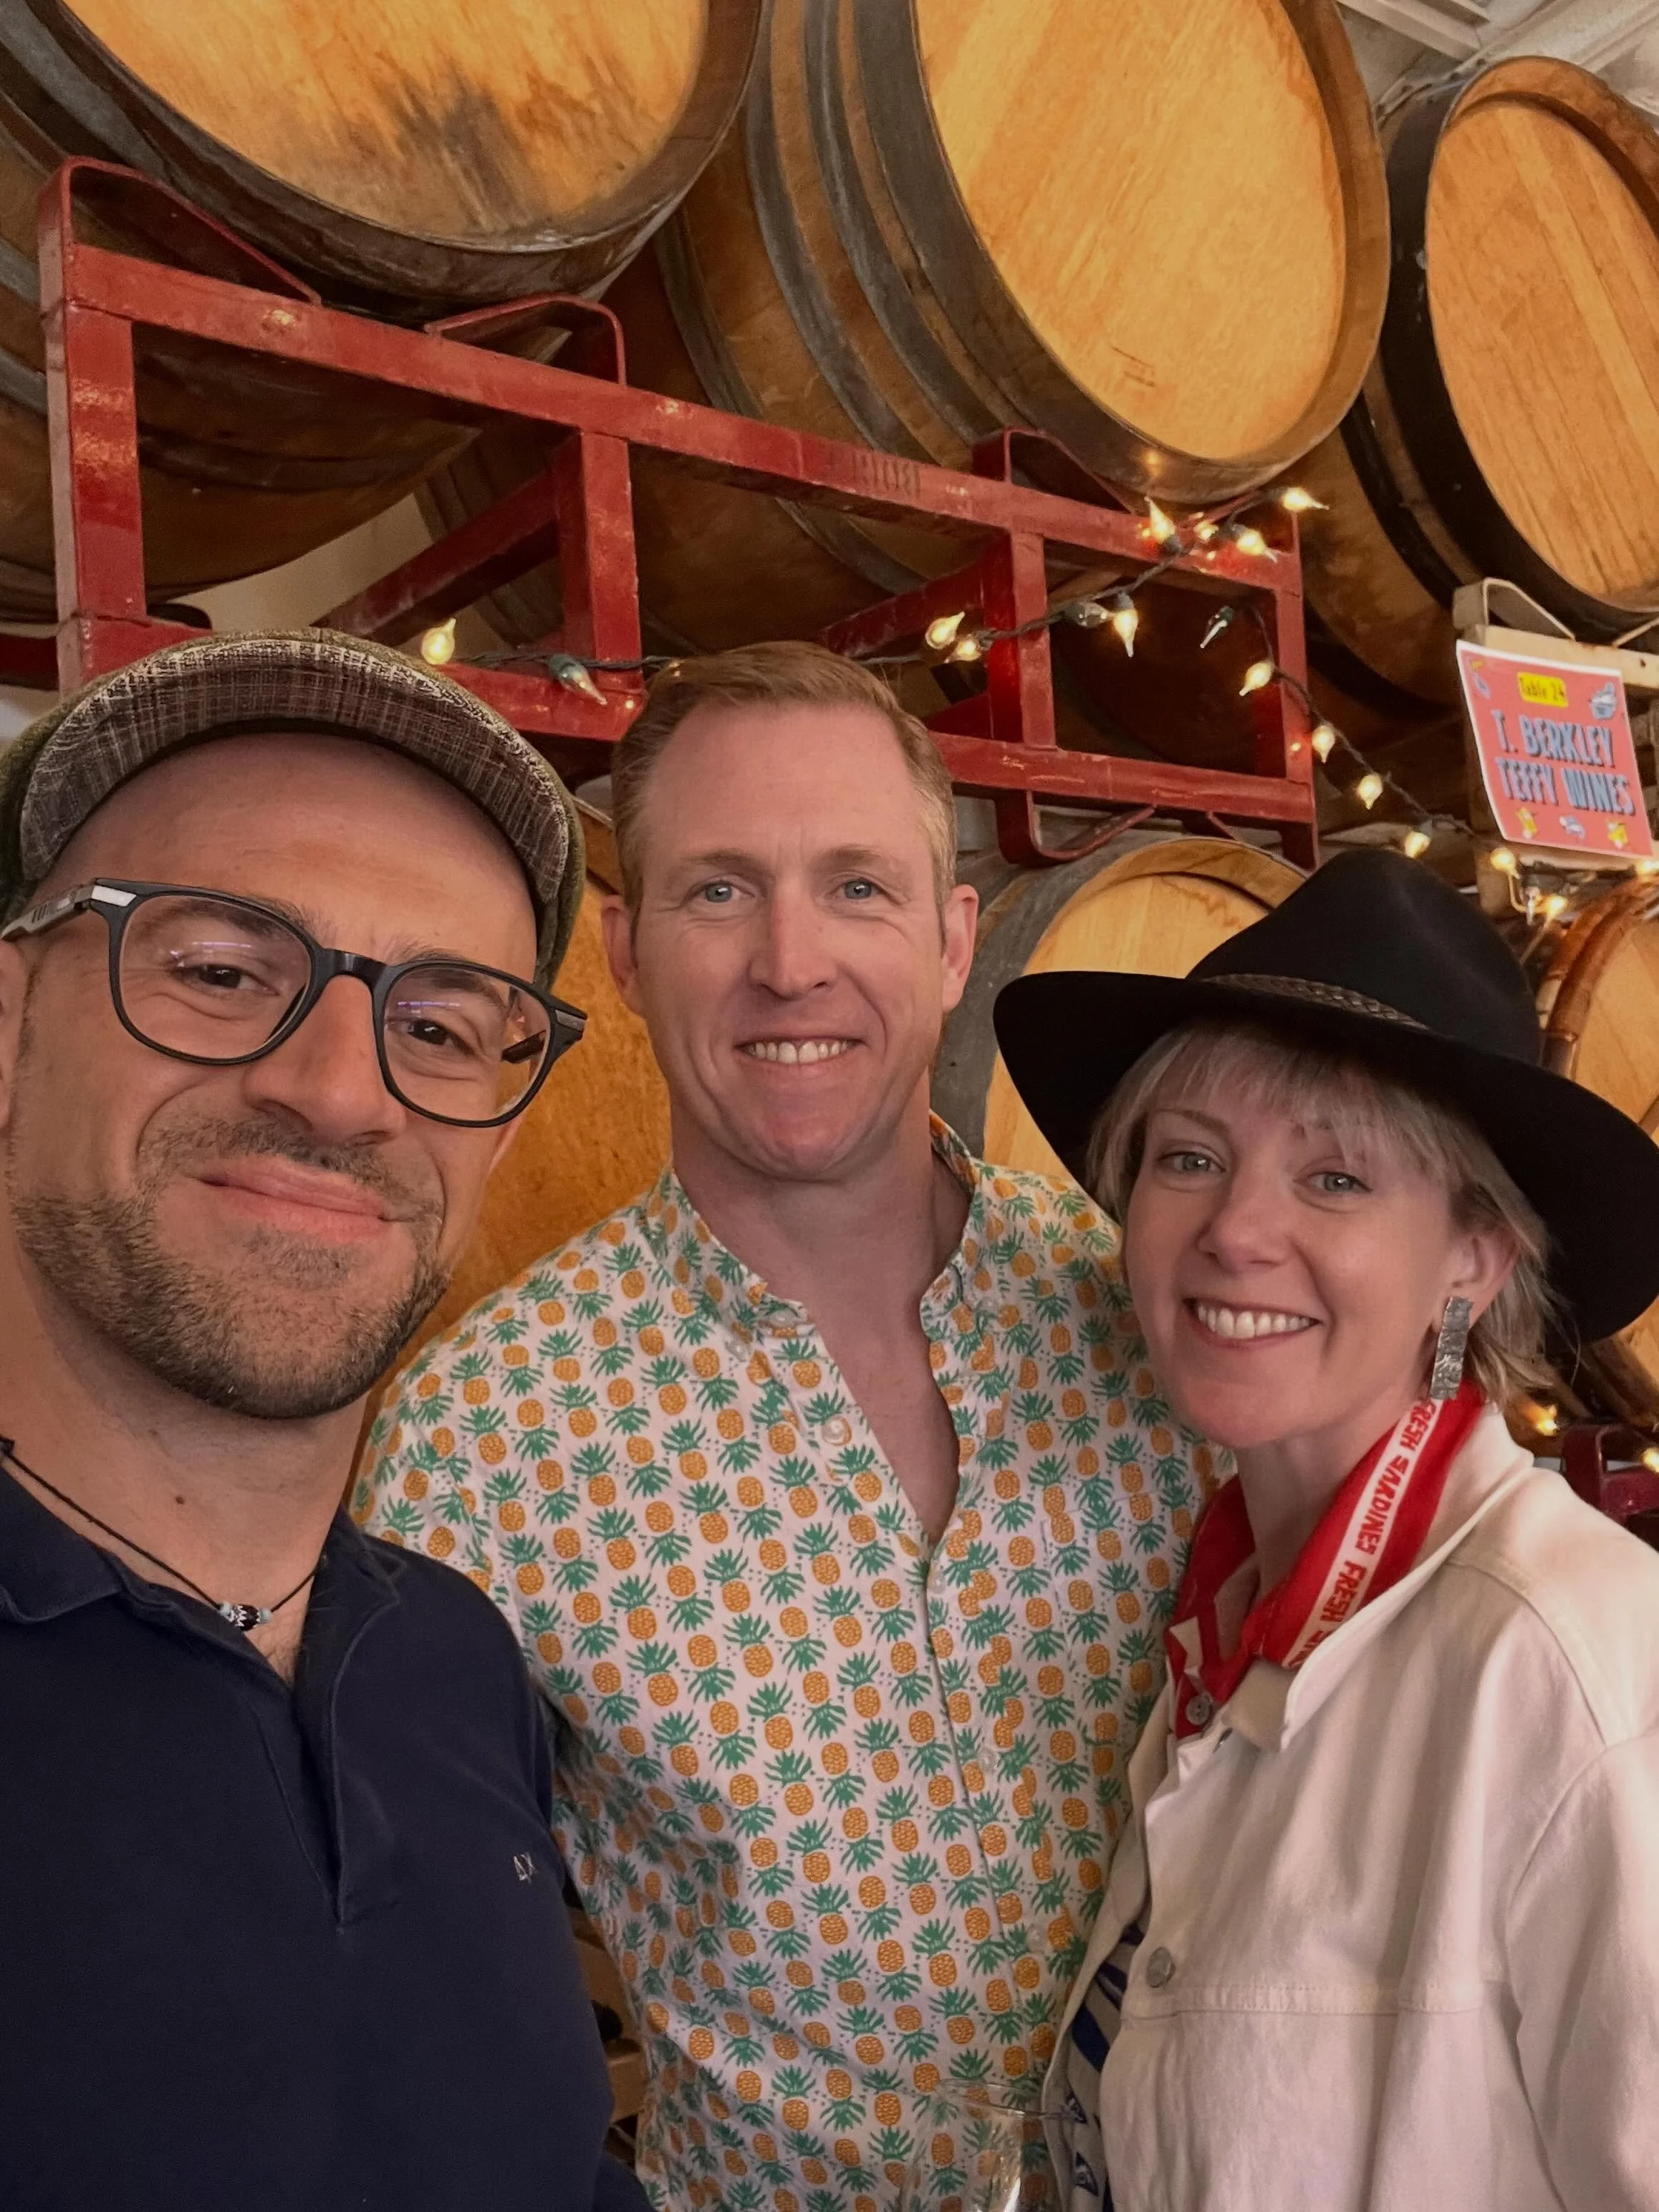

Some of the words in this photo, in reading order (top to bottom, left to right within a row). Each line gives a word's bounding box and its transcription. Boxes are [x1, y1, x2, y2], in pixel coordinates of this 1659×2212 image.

[1519, 715, 1615, 768] BERKLEY
[1561, 768, 1635, 816] WINES
[1399, 1401, 1437, 1452] FRESH
[1355, 1455, 1409, 1554] SARDINES
[1321, 1561, 1367, 1622] FRESH
